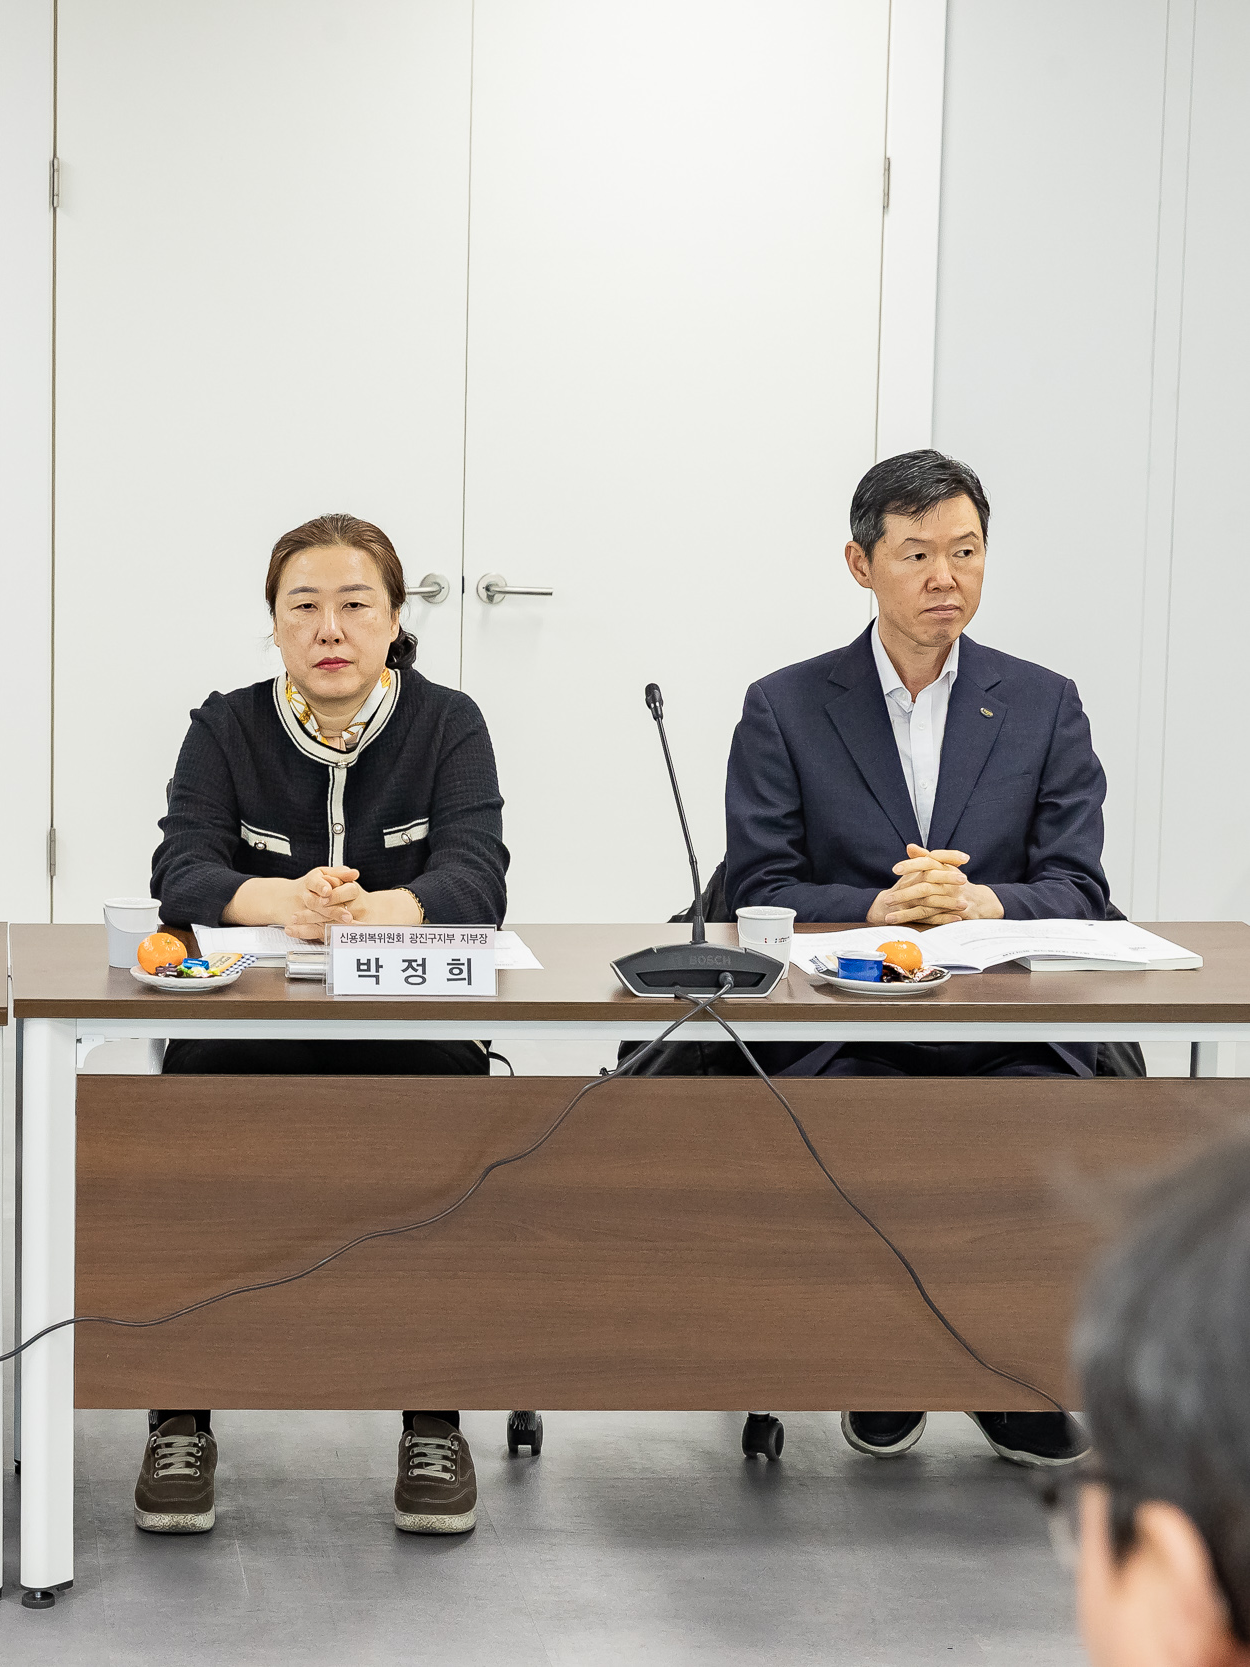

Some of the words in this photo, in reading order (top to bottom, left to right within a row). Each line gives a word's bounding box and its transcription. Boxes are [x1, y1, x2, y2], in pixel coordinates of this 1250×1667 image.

[340, 932, 404, 944] 신용회복위원회
[409, 932, 456, 944] 광진구지부
[460, 932, 488, 945] 지부장
[689, 955, 732, 966] BOSCH
